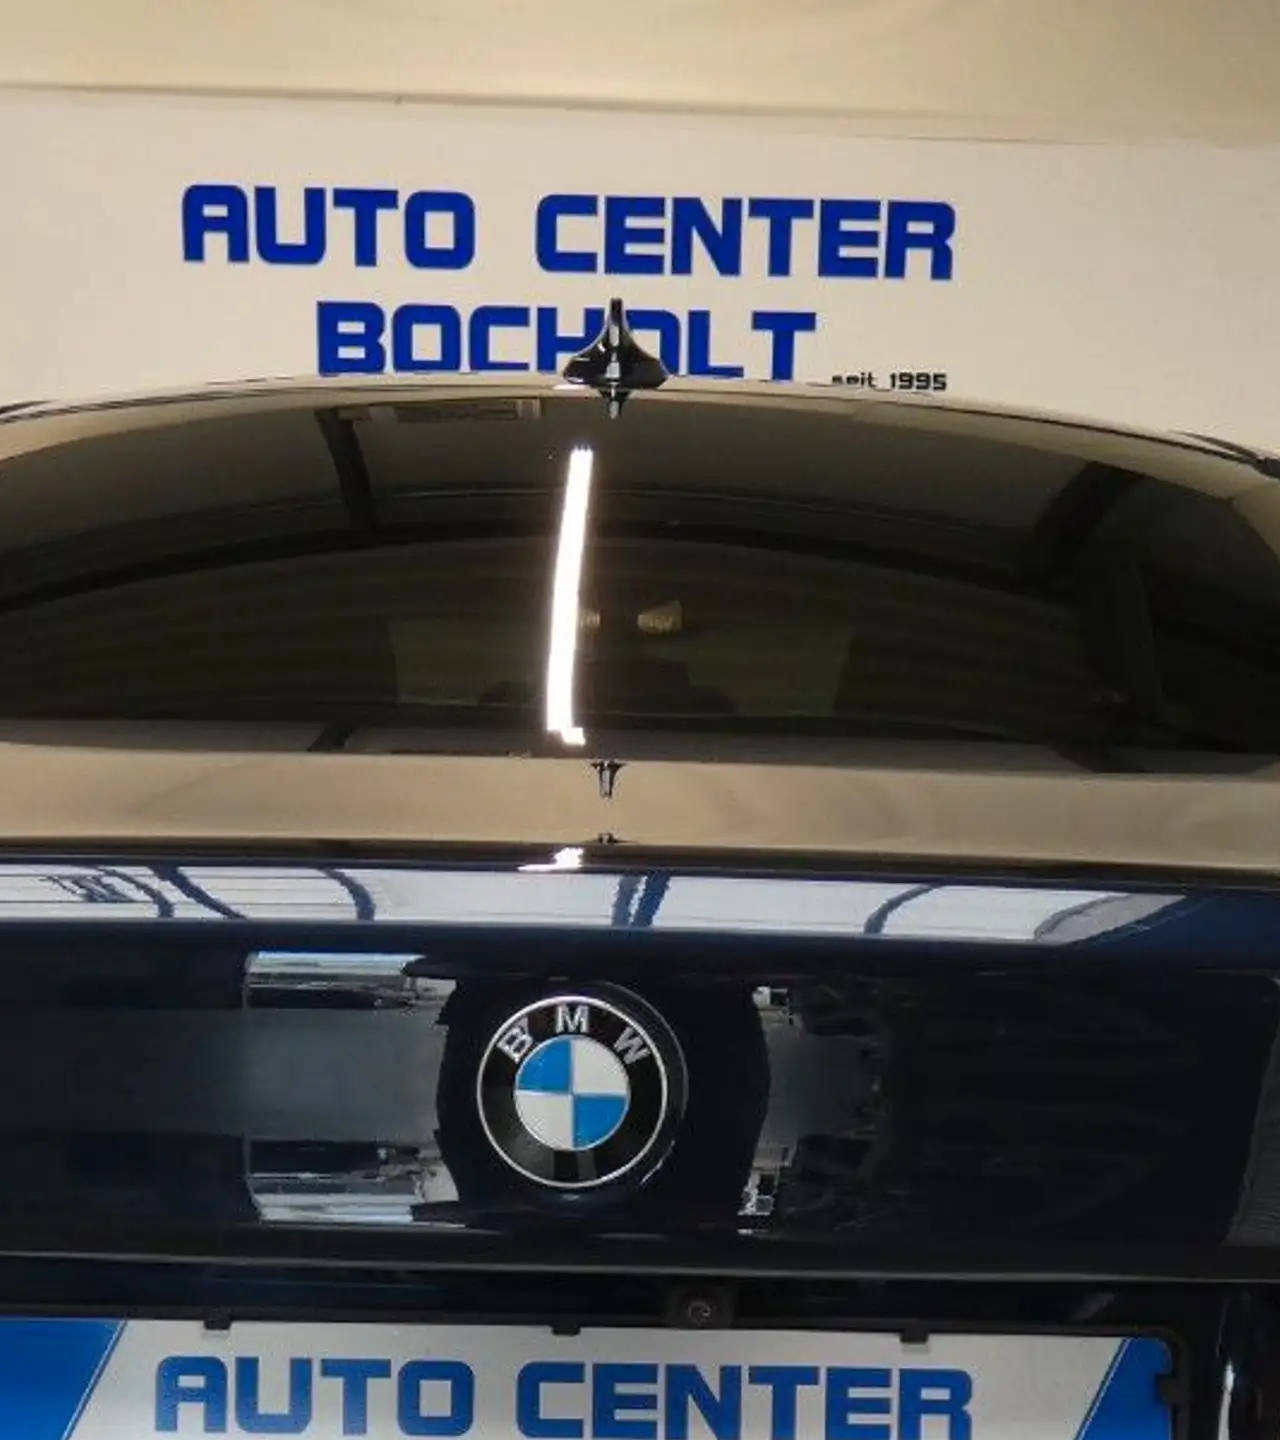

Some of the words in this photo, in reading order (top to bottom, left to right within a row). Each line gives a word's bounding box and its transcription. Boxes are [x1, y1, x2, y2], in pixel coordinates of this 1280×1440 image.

[181, 184, 475, 270] AUTO
[536, 193, 956, 280] CENTER
[890, 372, 947, 391] 1995
[496, 1003, 651, 1064] BMW
[155, 1356, 474, 1437] AUTO
